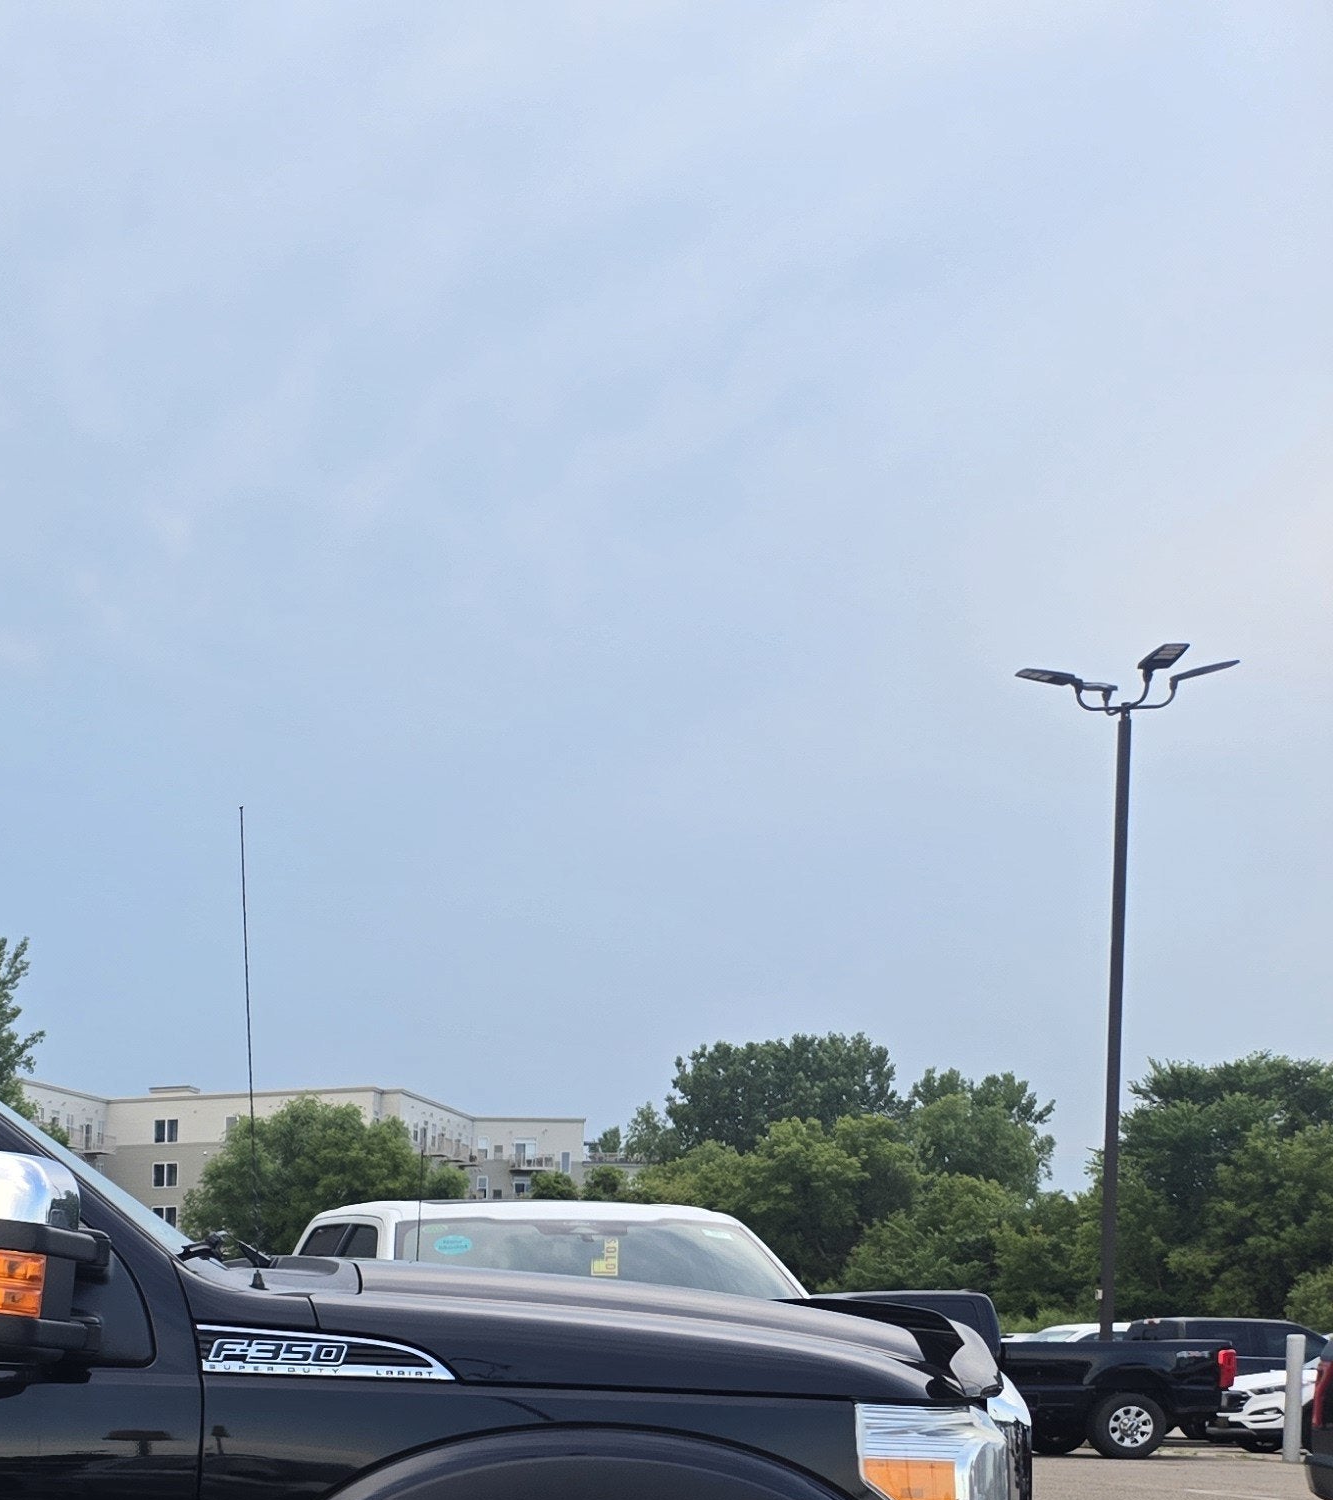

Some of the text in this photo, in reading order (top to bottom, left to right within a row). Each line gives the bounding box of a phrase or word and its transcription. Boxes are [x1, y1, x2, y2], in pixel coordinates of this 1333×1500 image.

[208, 1338, 348, 1366] F-350
[208, 1364, 340, 1374] SUPER DUTY
[375, 1369, 434, 1377] LARIAT
